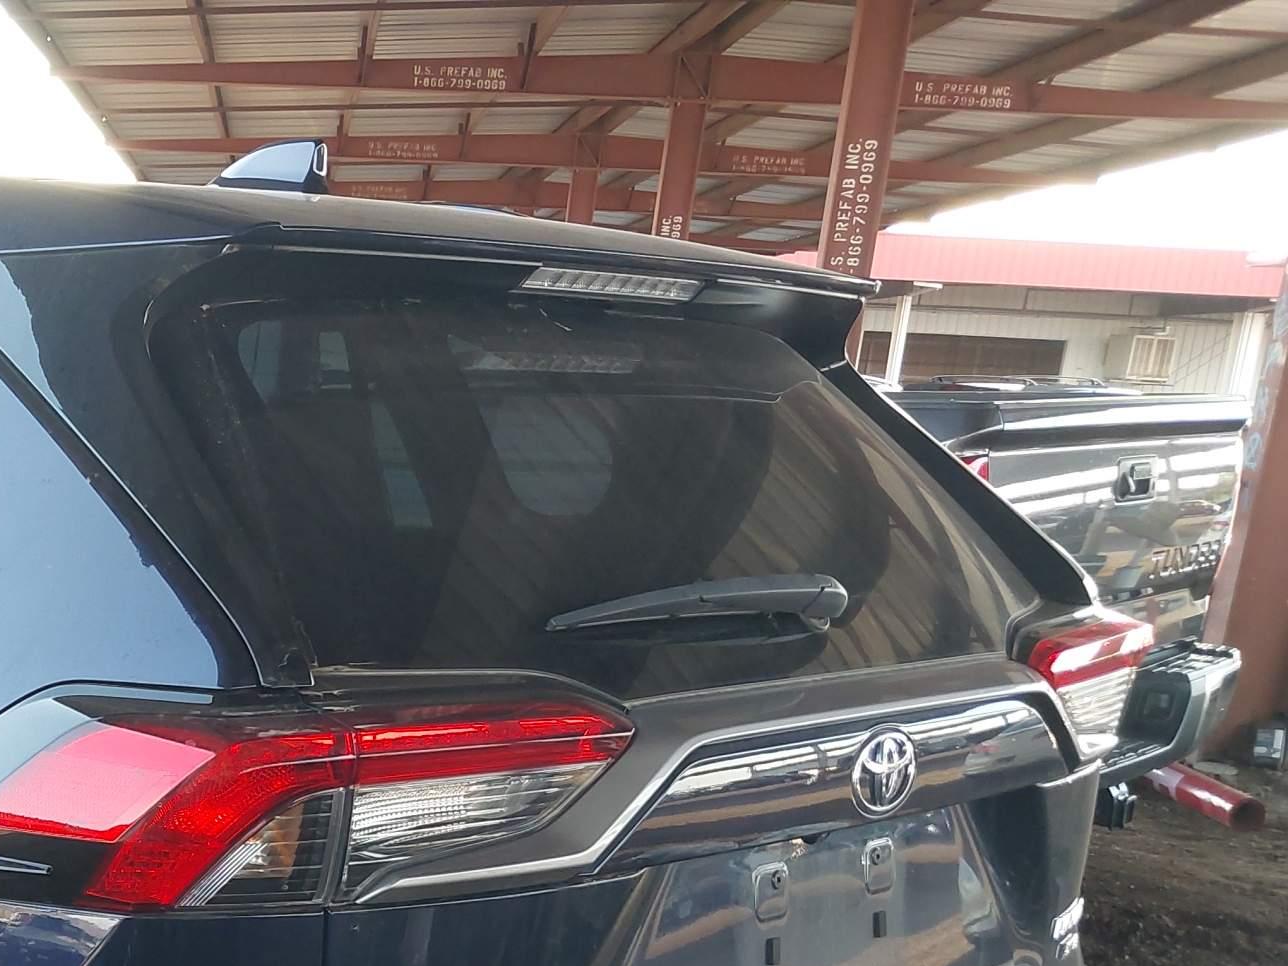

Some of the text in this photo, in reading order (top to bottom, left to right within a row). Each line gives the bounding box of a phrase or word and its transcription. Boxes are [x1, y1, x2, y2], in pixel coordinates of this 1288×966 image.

[440, 66, 482, 78] PREFAB
[487, 67, 508, 79] INC.
[414, 76, 506, 90] 1-866-799-0969
[943, 82, 988, 96] PREFAB
[914, 93, 1012, 109] 1-866-799-0969
[844, 138, 863, 170] INC.
[833, 178, 856, 242] PREFAB
[846, 139, 878, 275] -866-799-0969
[660, 215, 672, 236] INC.
